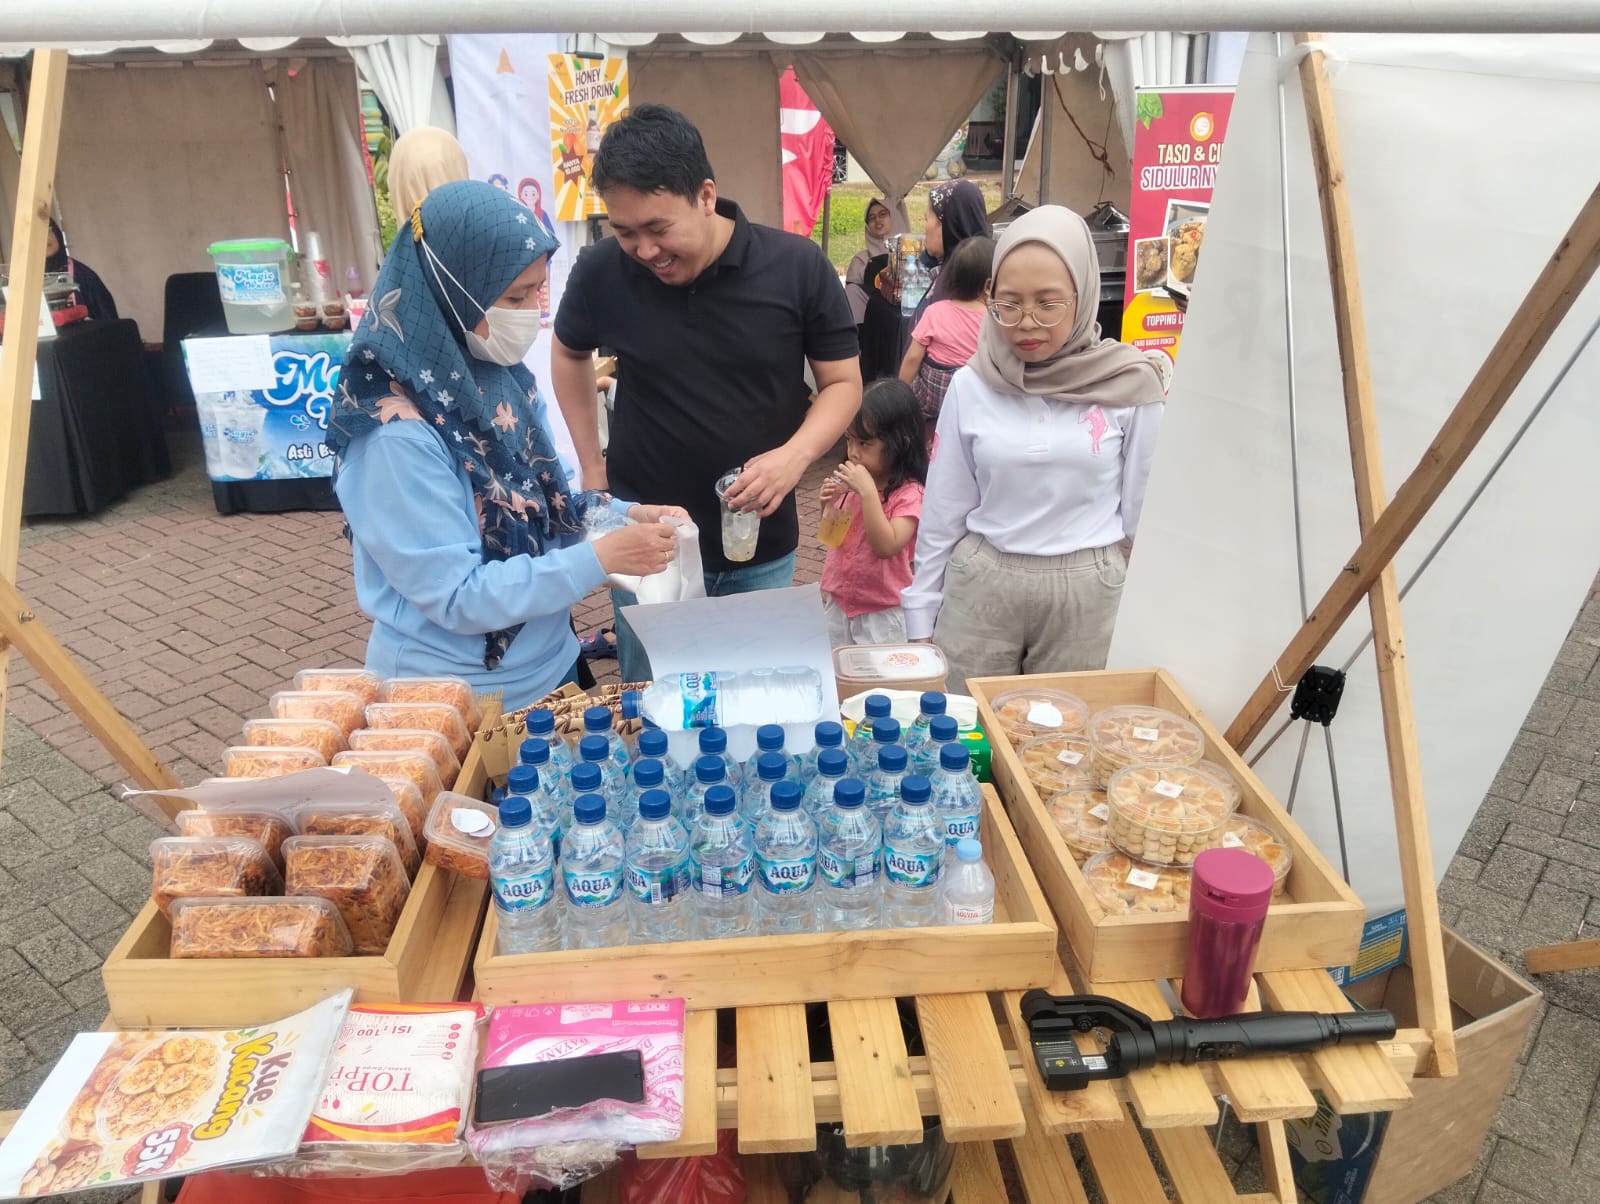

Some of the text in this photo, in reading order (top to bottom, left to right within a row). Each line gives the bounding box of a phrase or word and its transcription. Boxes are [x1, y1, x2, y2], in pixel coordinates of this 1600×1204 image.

[575, 69, 601, 86] HONEY
[565, 82, 616, 104] FRESH DRINK
[1158, 143, 1190, 164] TASO
[1193, 145, 1205, 161] &
[1146, 314, 1177, 326] TOPPING
[288, 443, 313, 460] Asli
[945, 821, 975, 837] QUA
[770, 863, 809, 880] AQUA
[888, 854, 926, 874] AQUA
[501, 881, 543, 897] AQUA
[572, 878, 612, 894] AQUA
[357, 1028, 380, 1037] 100
[391, 1025, 412, 1034] ISI
[191, 1032, 278, 1140] Kacang
[248, 1052, 292, 1104] Kue
[133, 1127, 182, 1175] 55K
